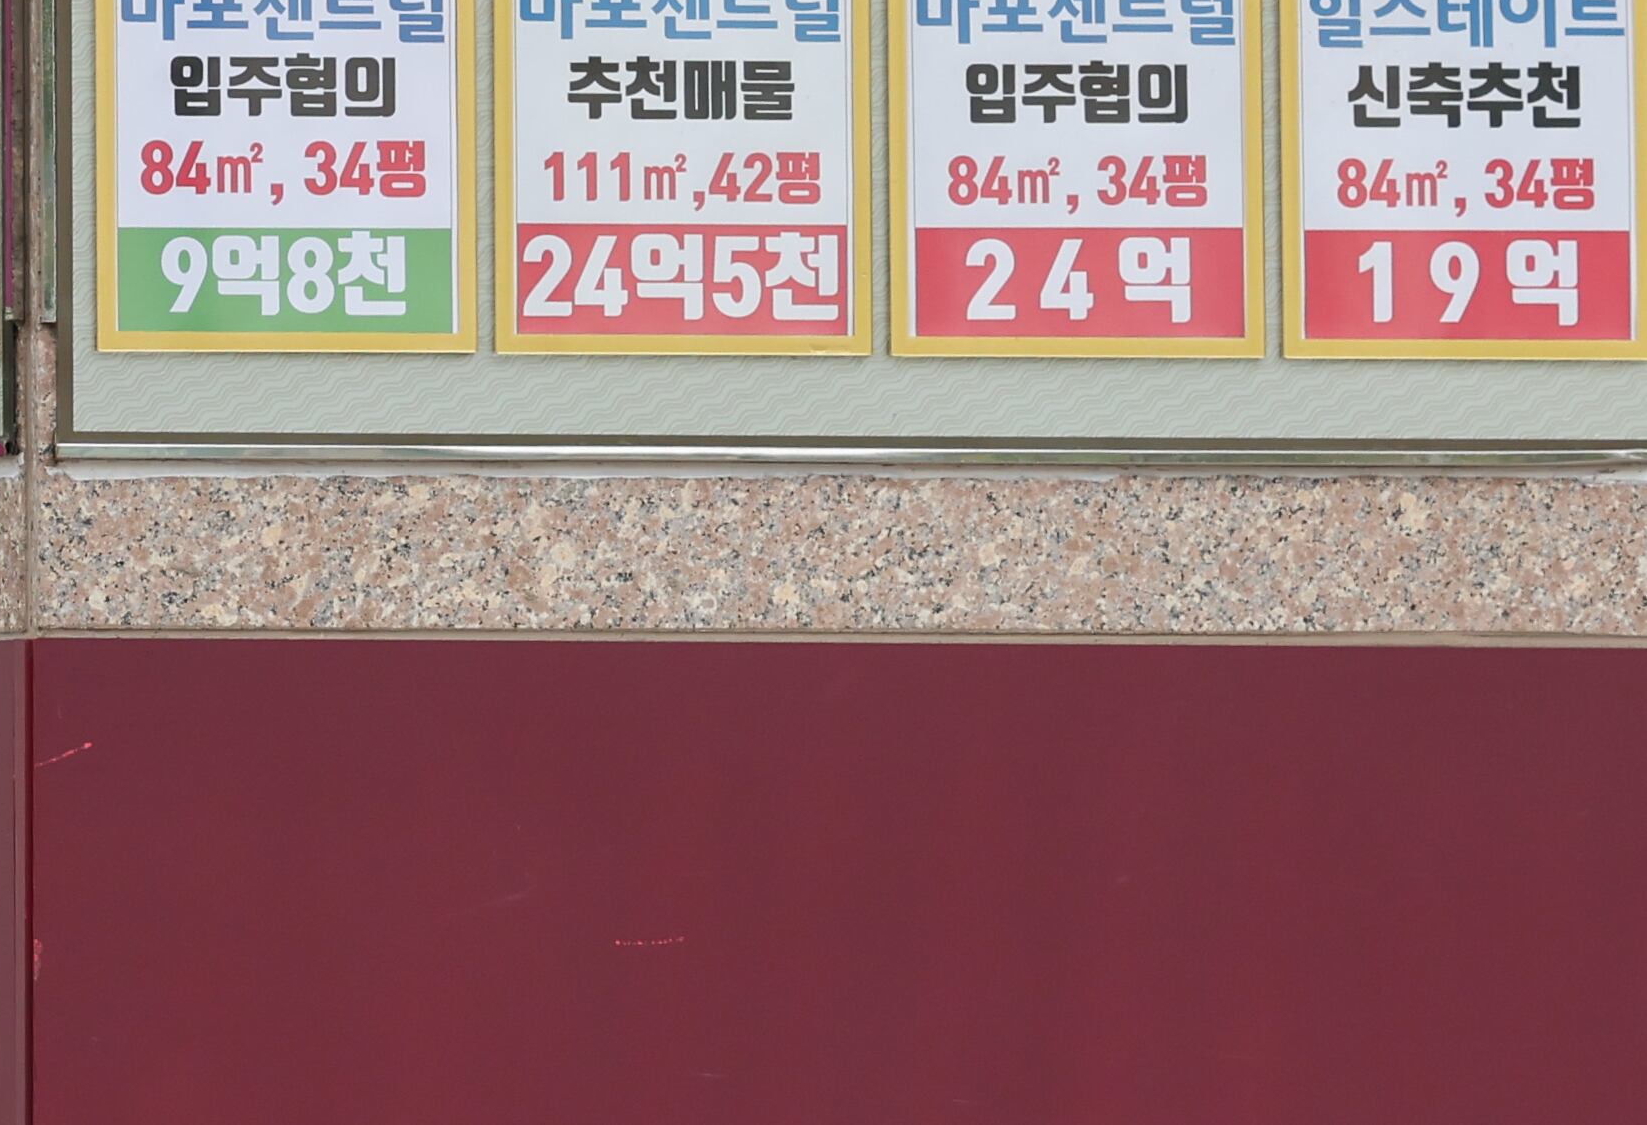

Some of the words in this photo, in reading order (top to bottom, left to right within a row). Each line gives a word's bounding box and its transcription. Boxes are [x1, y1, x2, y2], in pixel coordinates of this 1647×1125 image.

[171, 53, 395, 117] 입주협의
[568, 56, 794, 120] 추천매물
[966, 61, 1188, 123] 입주협의
[1348, 62, 1580, 128] 신축추천
[304, 141, 426, 197] 34평
[1097, 155, 1207, 207] 34평
[1485, 159, 1594, 210] 34평
[161, 231, 406, 315] 9억8천
[523, 232, 838, 320] 24억5천
